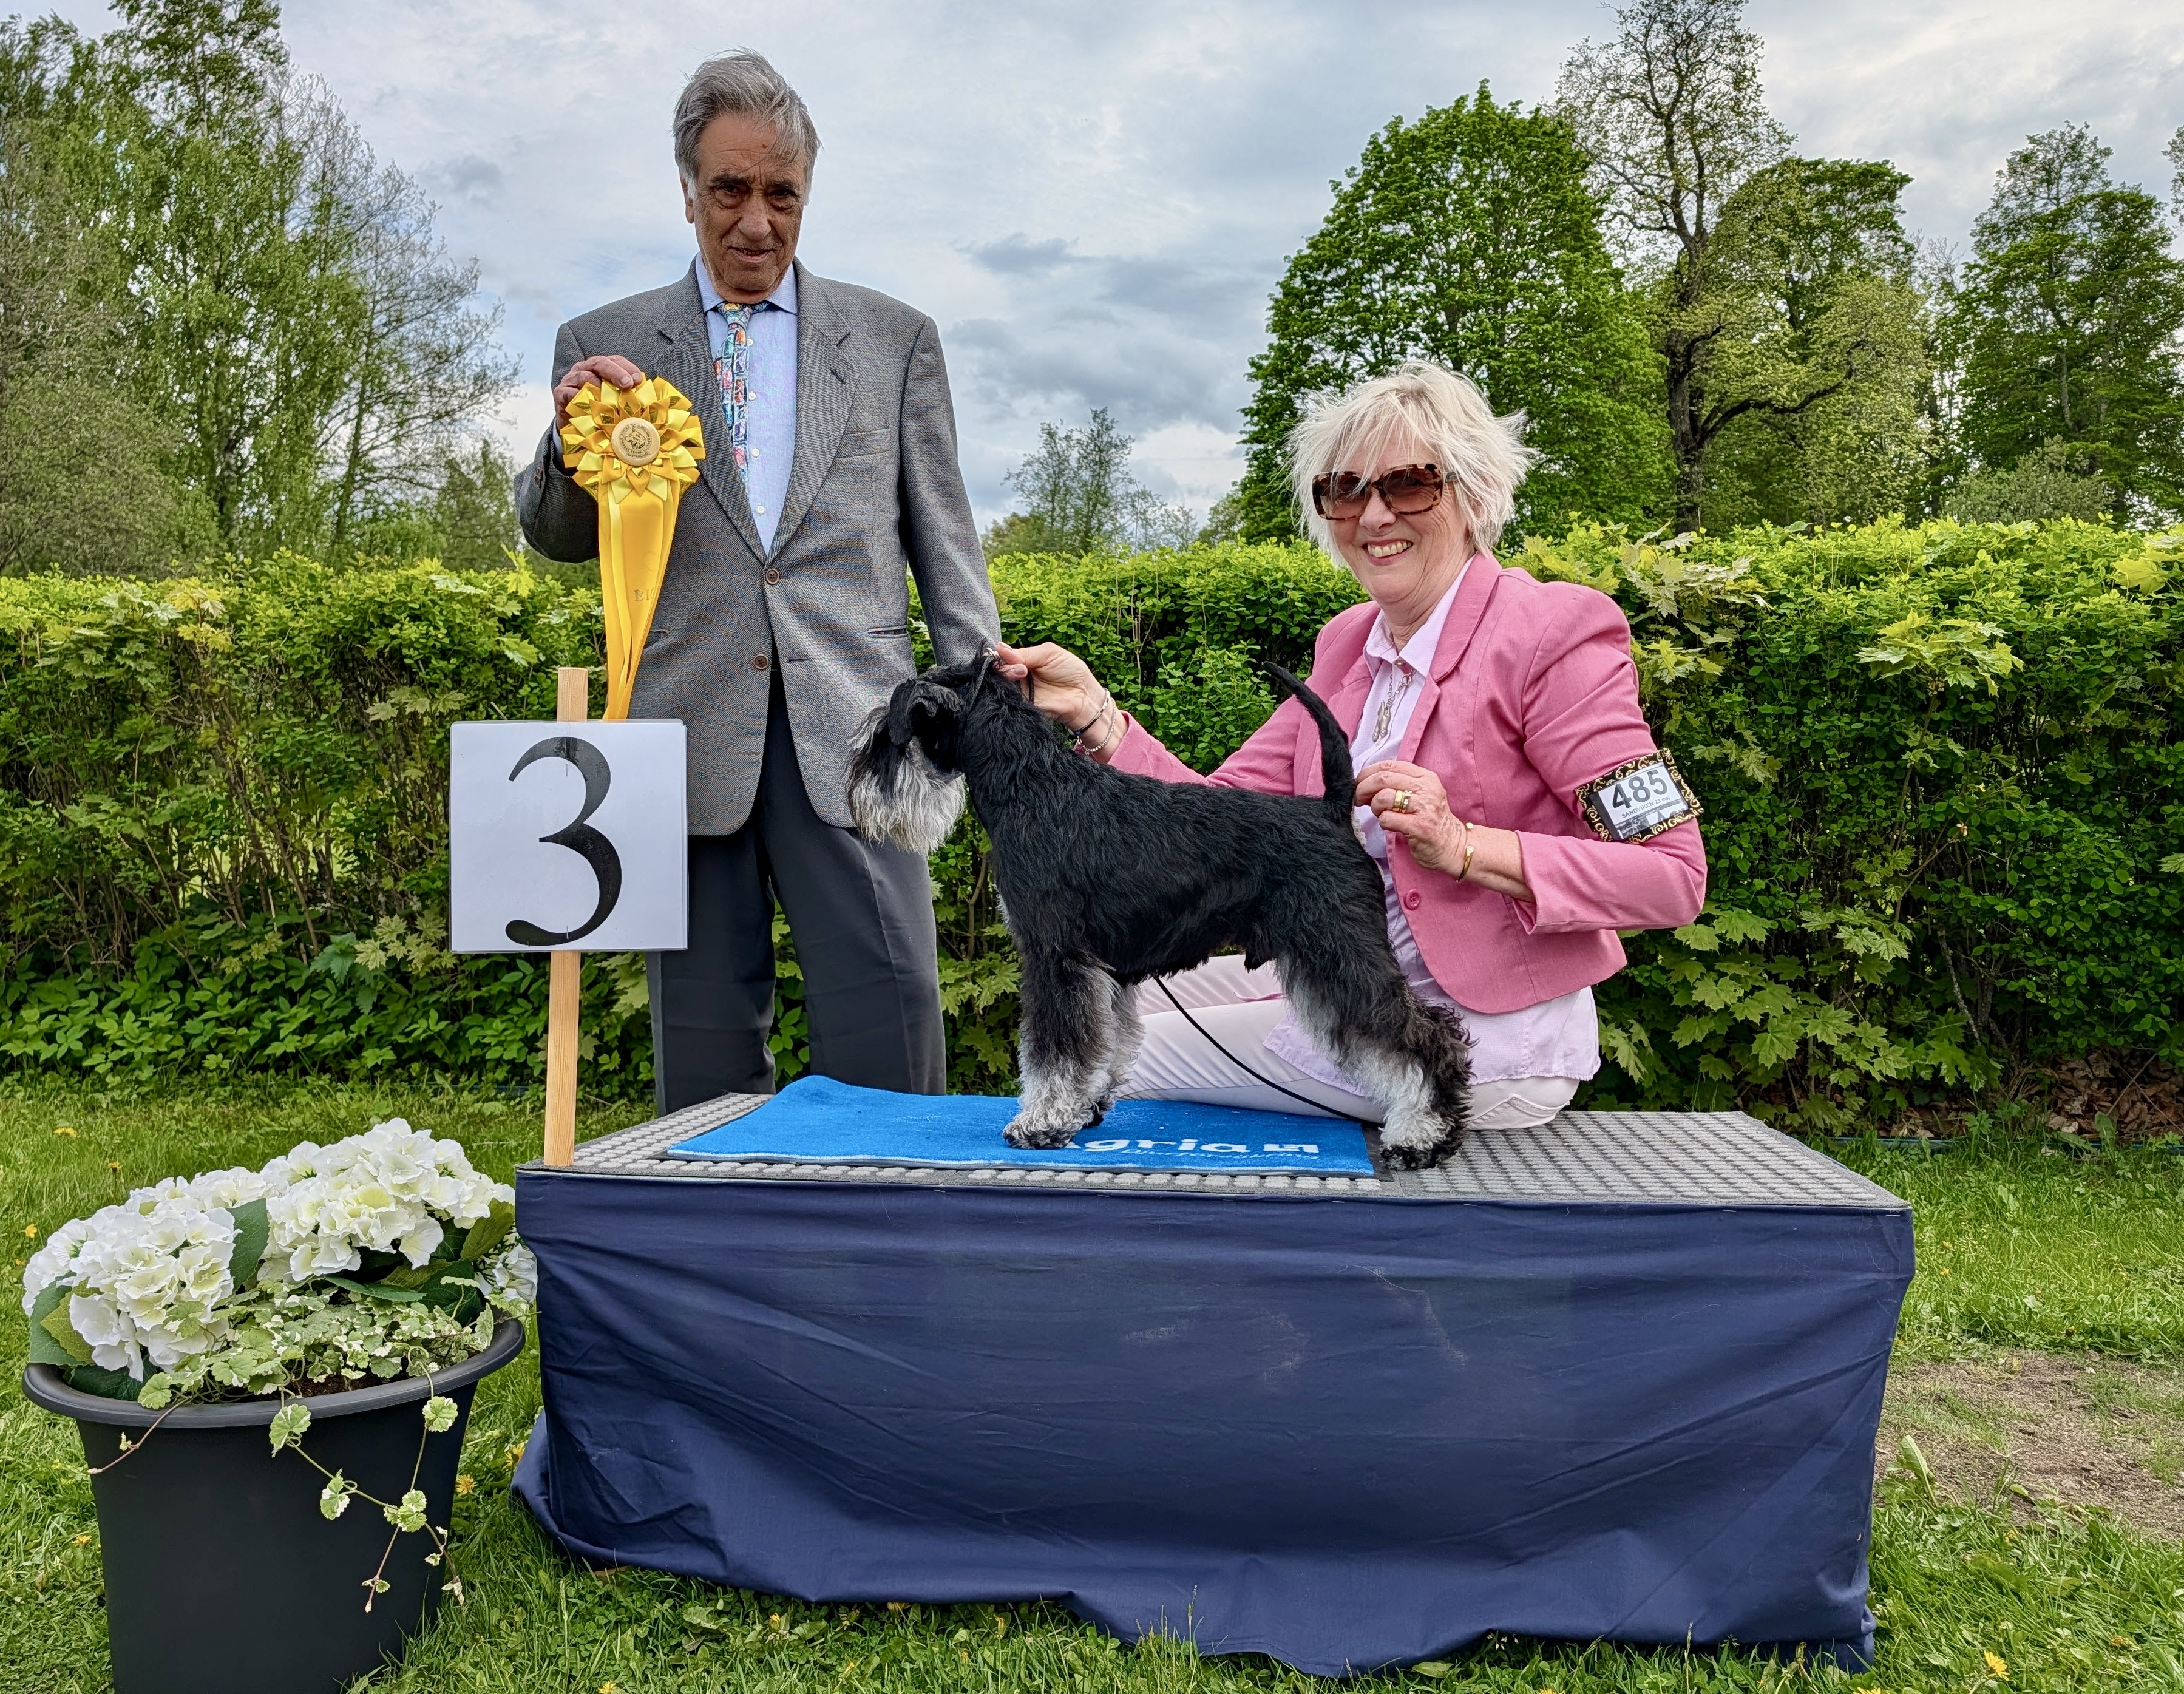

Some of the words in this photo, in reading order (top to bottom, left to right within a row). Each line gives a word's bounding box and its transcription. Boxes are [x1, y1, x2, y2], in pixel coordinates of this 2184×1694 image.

[1612, 770, 1668, 809] 485
[1621, 801, 1654, 818] SANDVIKEN
[506, 736, 622, 946] 3
[1064, 1139, 1251, 1153] gria
